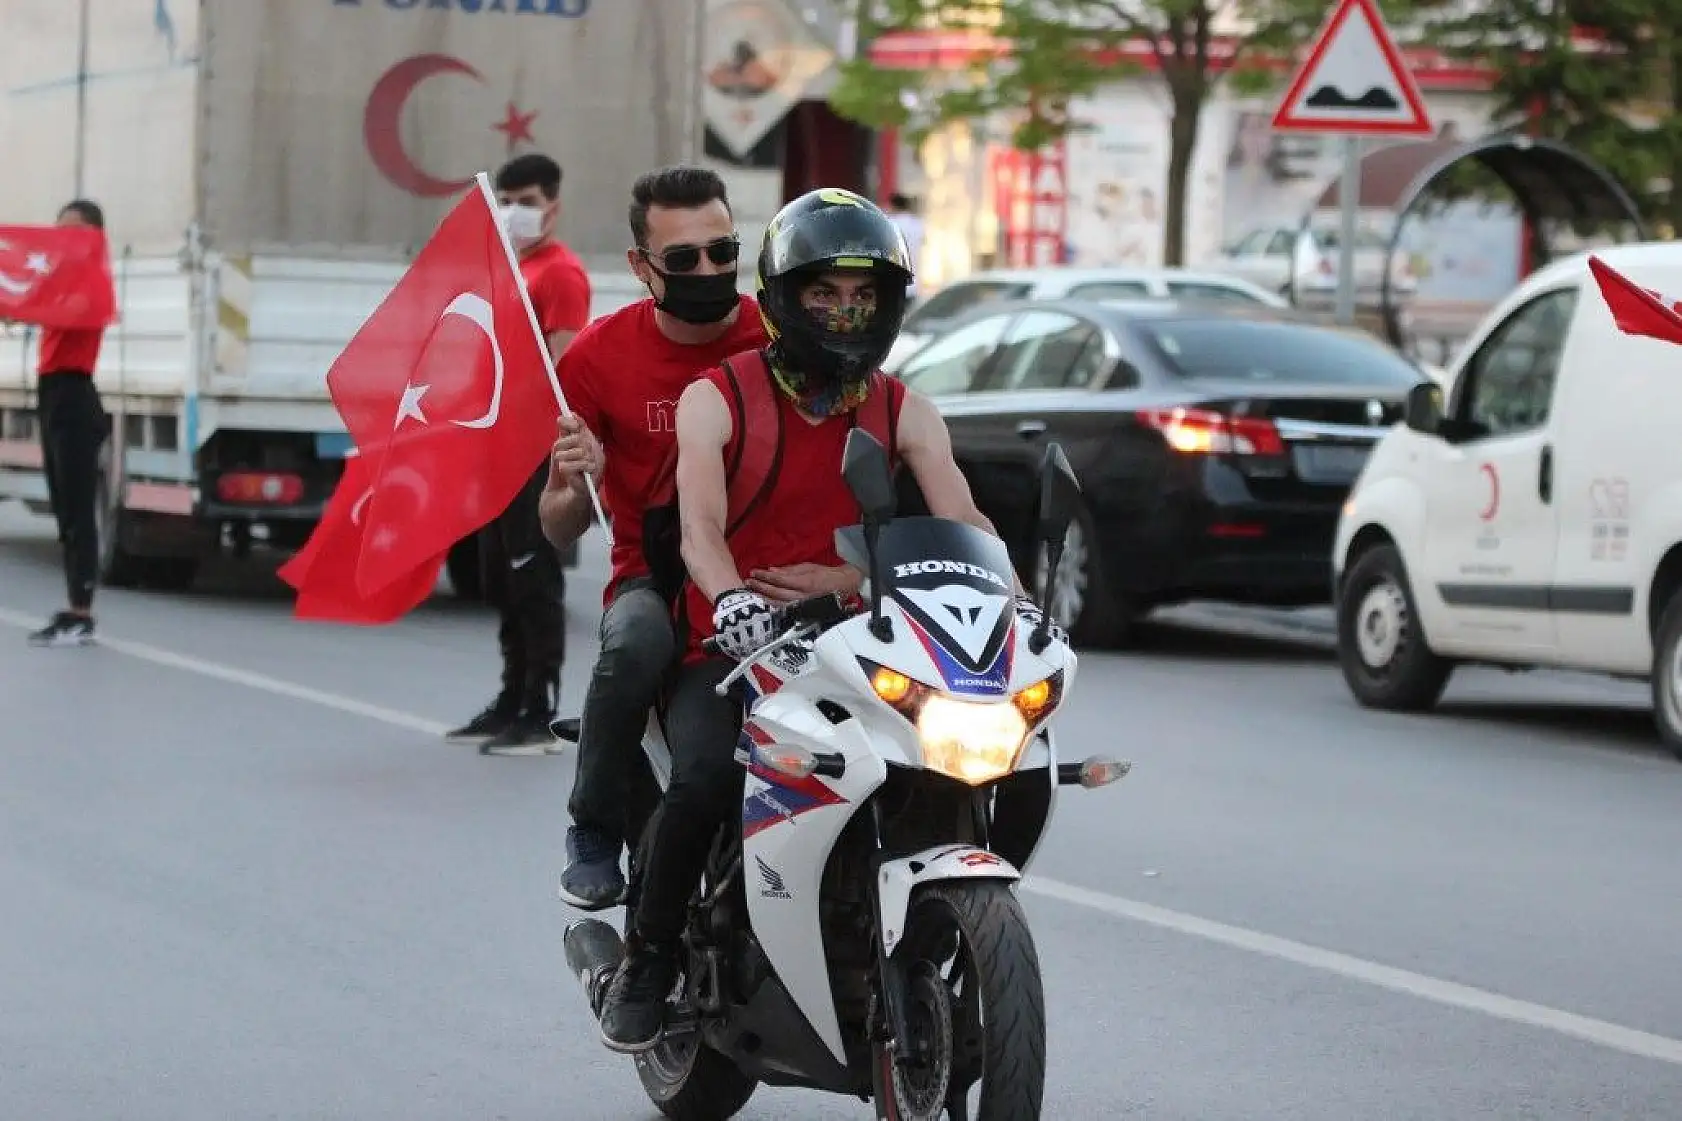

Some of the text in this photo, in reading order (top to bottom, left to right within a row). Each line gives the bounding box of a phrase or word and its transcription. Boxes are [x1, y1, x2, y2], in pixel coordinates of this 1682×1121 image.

[893, 560, 1008, 590] HONDA
[954, 679, 1007, 689] HONDA
[761, 890, 792, 900] HONDA
